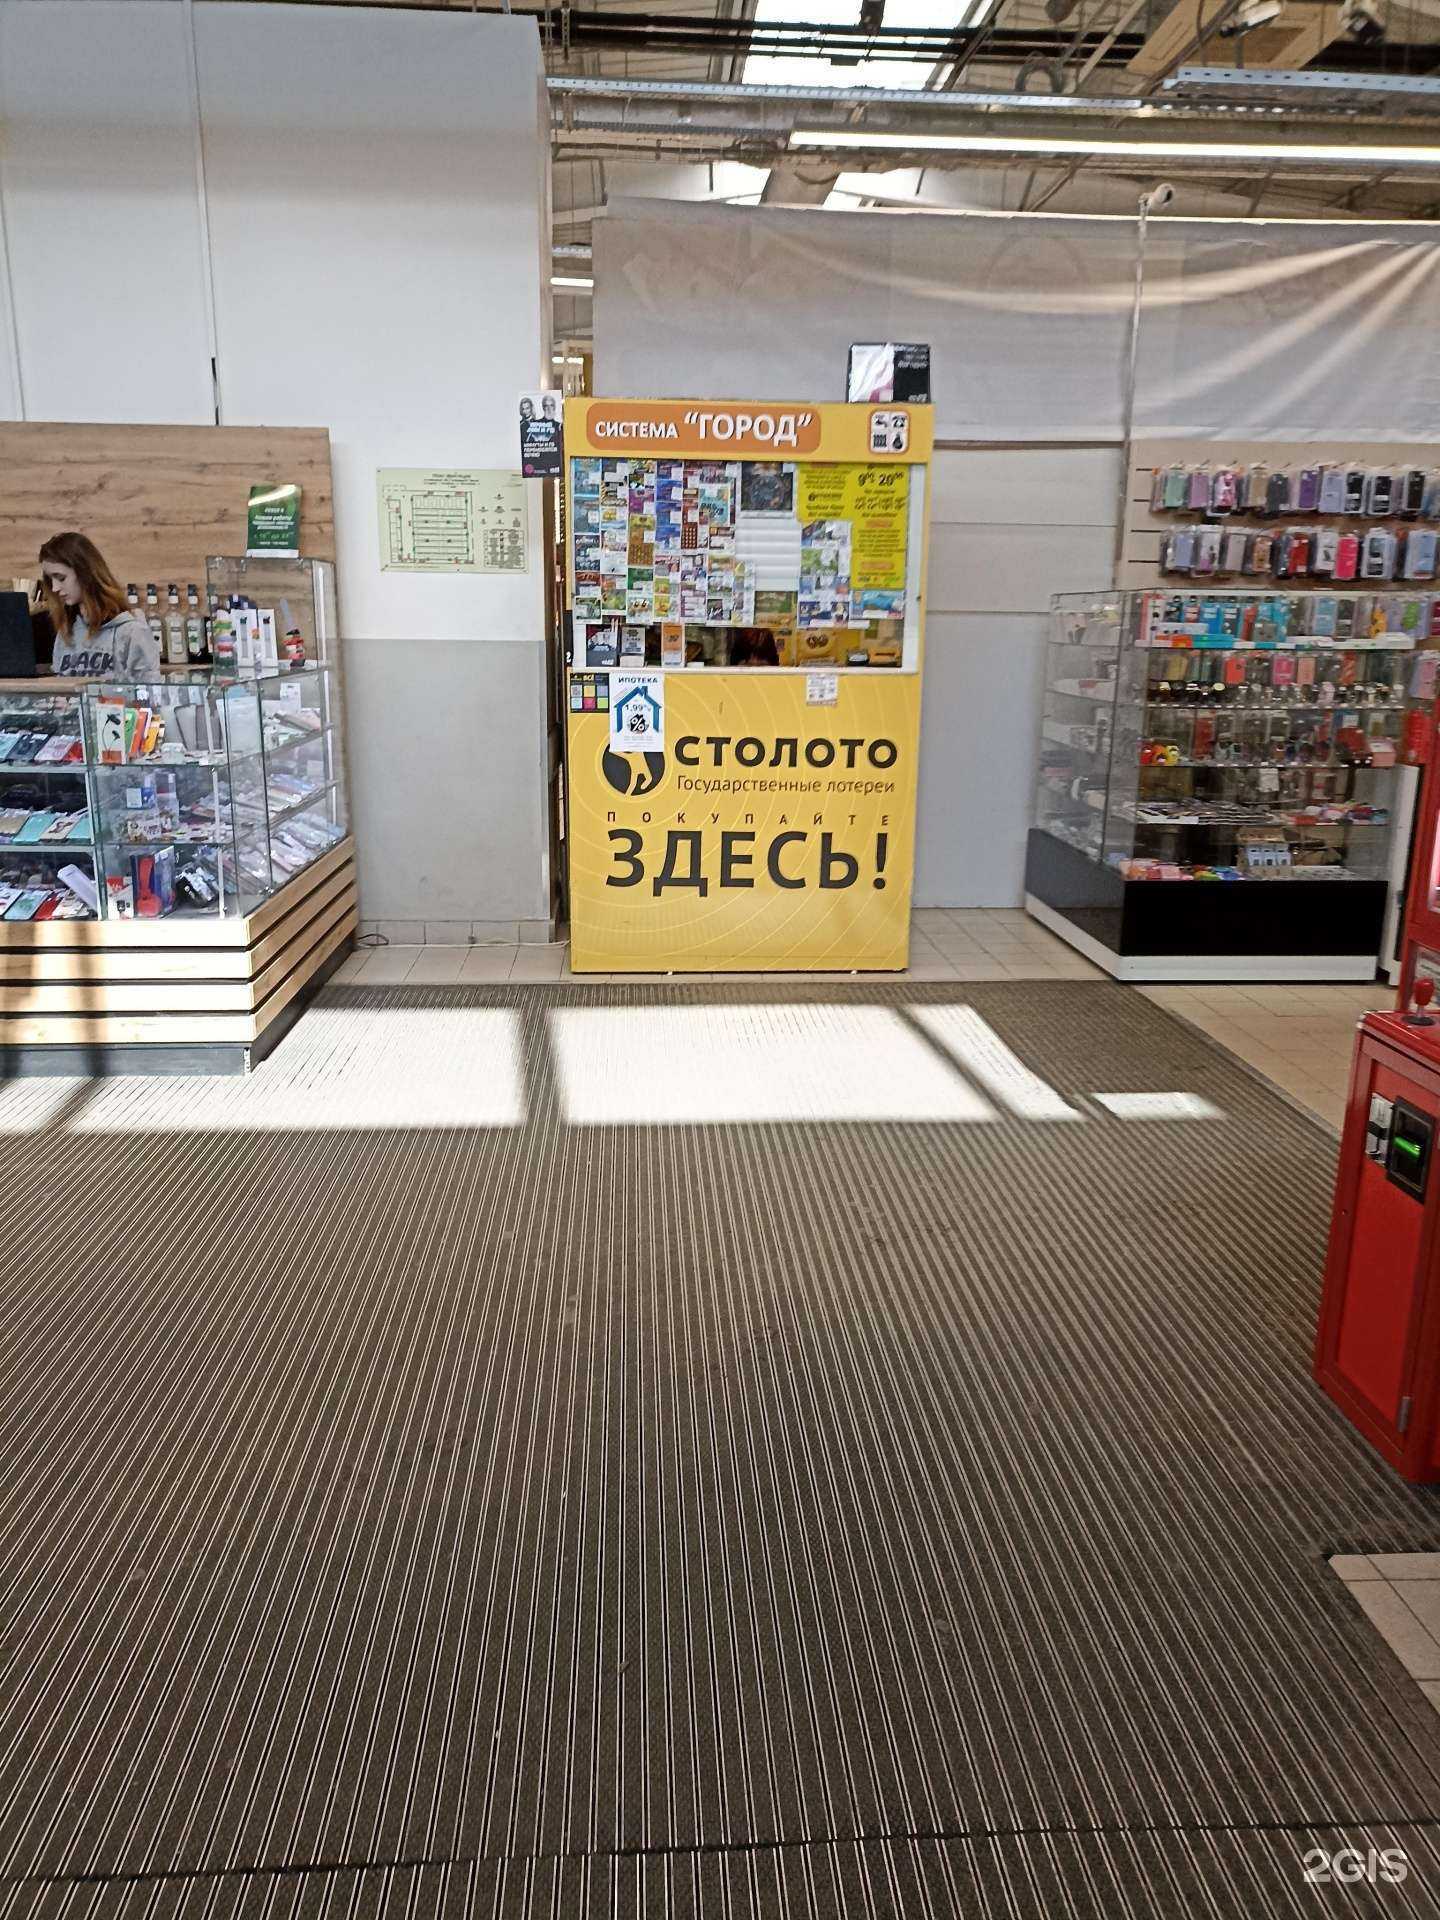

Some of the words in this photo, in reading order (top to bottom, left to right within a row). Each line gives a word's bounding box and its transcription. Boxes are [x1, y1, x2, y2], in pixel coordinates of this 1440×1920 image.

[595, 420, 679, 439] СИСТЕМА
[618, 676, 659, 684] ИПОТЕКА
[677, 774, 822, 794] Государственные
[826, 779, 895, 795] лотереи
[607, 810, 889, 827] ПОКУПАЙТЕ
[605, 828, 889, 898] ЗДЕСЬ!
